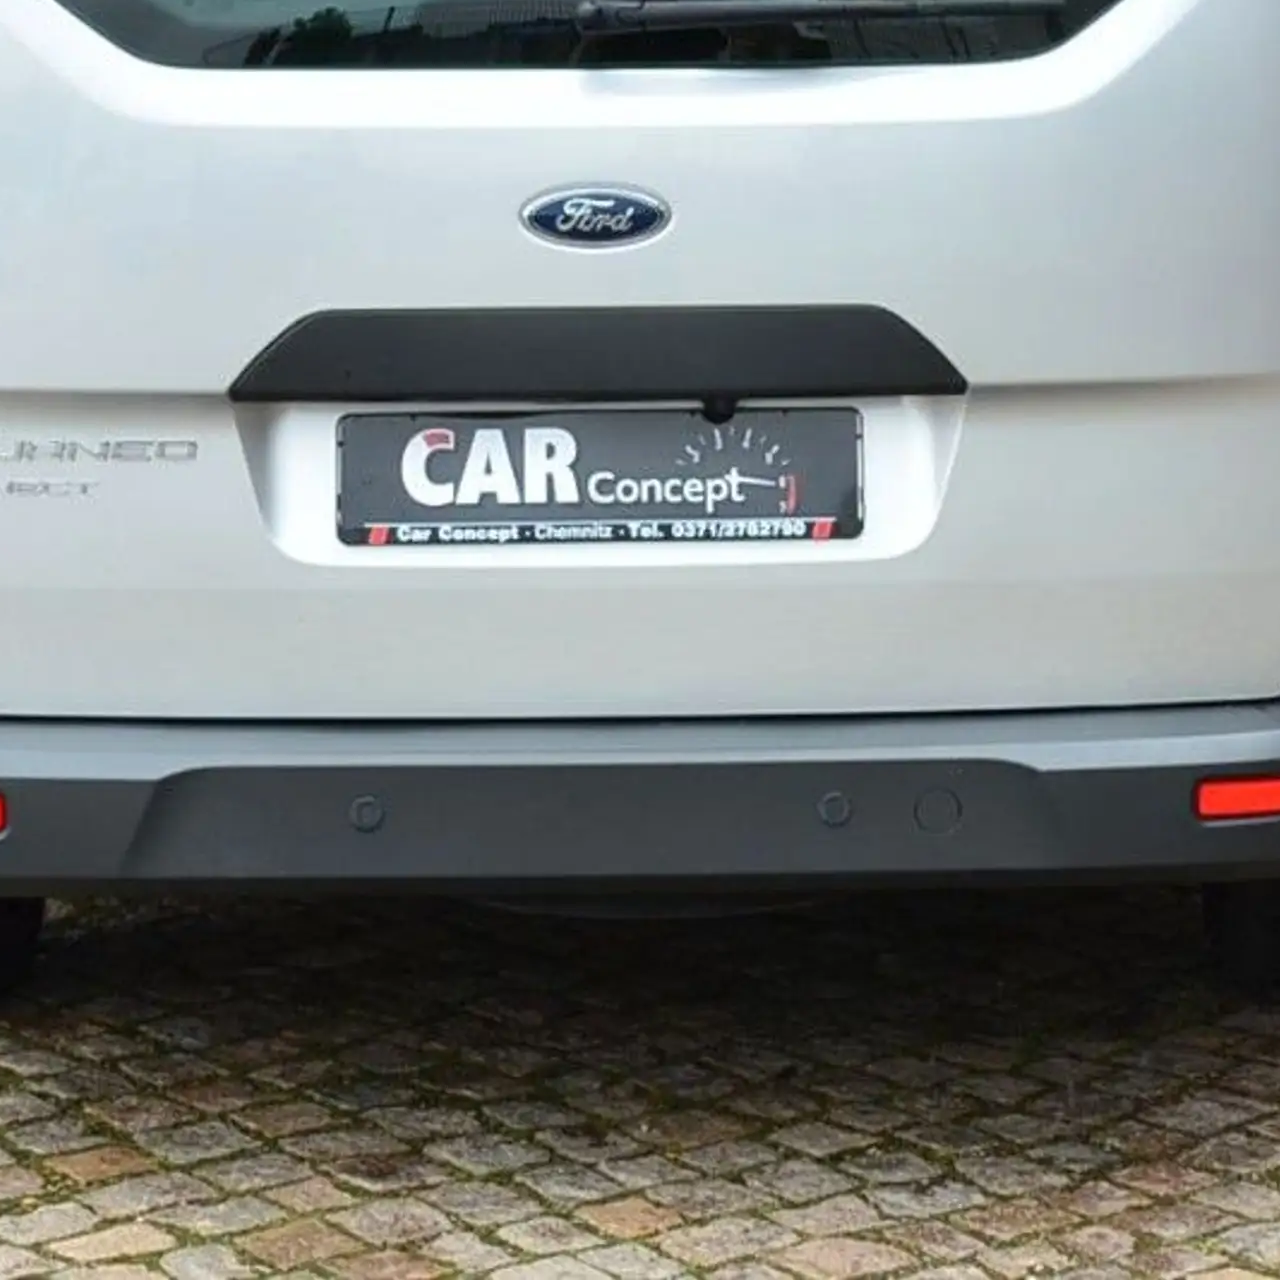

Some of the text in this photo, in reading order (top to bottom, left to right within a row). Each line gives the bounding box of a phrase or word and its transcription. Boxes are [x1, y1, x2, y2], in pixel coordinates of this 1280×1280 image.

[555, 197, 634, 232] Ford
[401, 427, 746, 514] CAR Concept
[397, 525, 431, 542] Car
[438, 524, 520, 543] Concept
[534, 523, 613, 540] Chemnitz
[628, 521, 664, 539] Tel.
